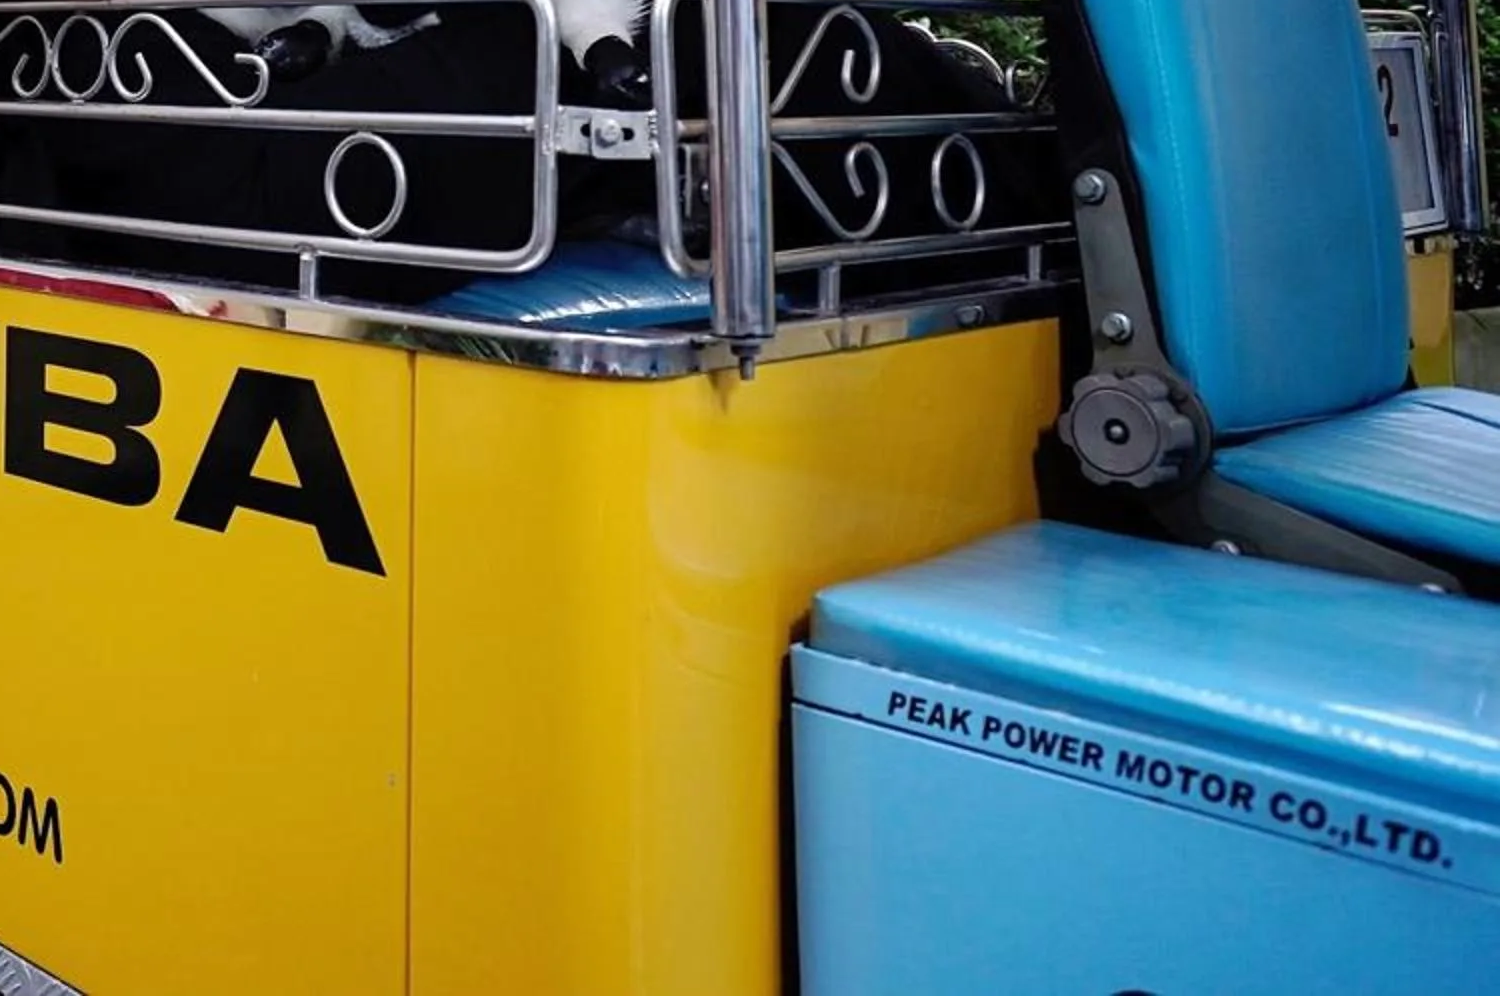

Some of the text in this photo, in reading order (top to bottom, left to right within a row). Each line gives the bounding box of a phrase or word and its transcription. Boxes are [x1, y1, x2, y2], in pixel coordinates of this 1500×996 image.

[1376, 64, 1399, 137] 2
[888, 691, 1453, 869] PEAK POWER MOTOR CO.,LTD.
